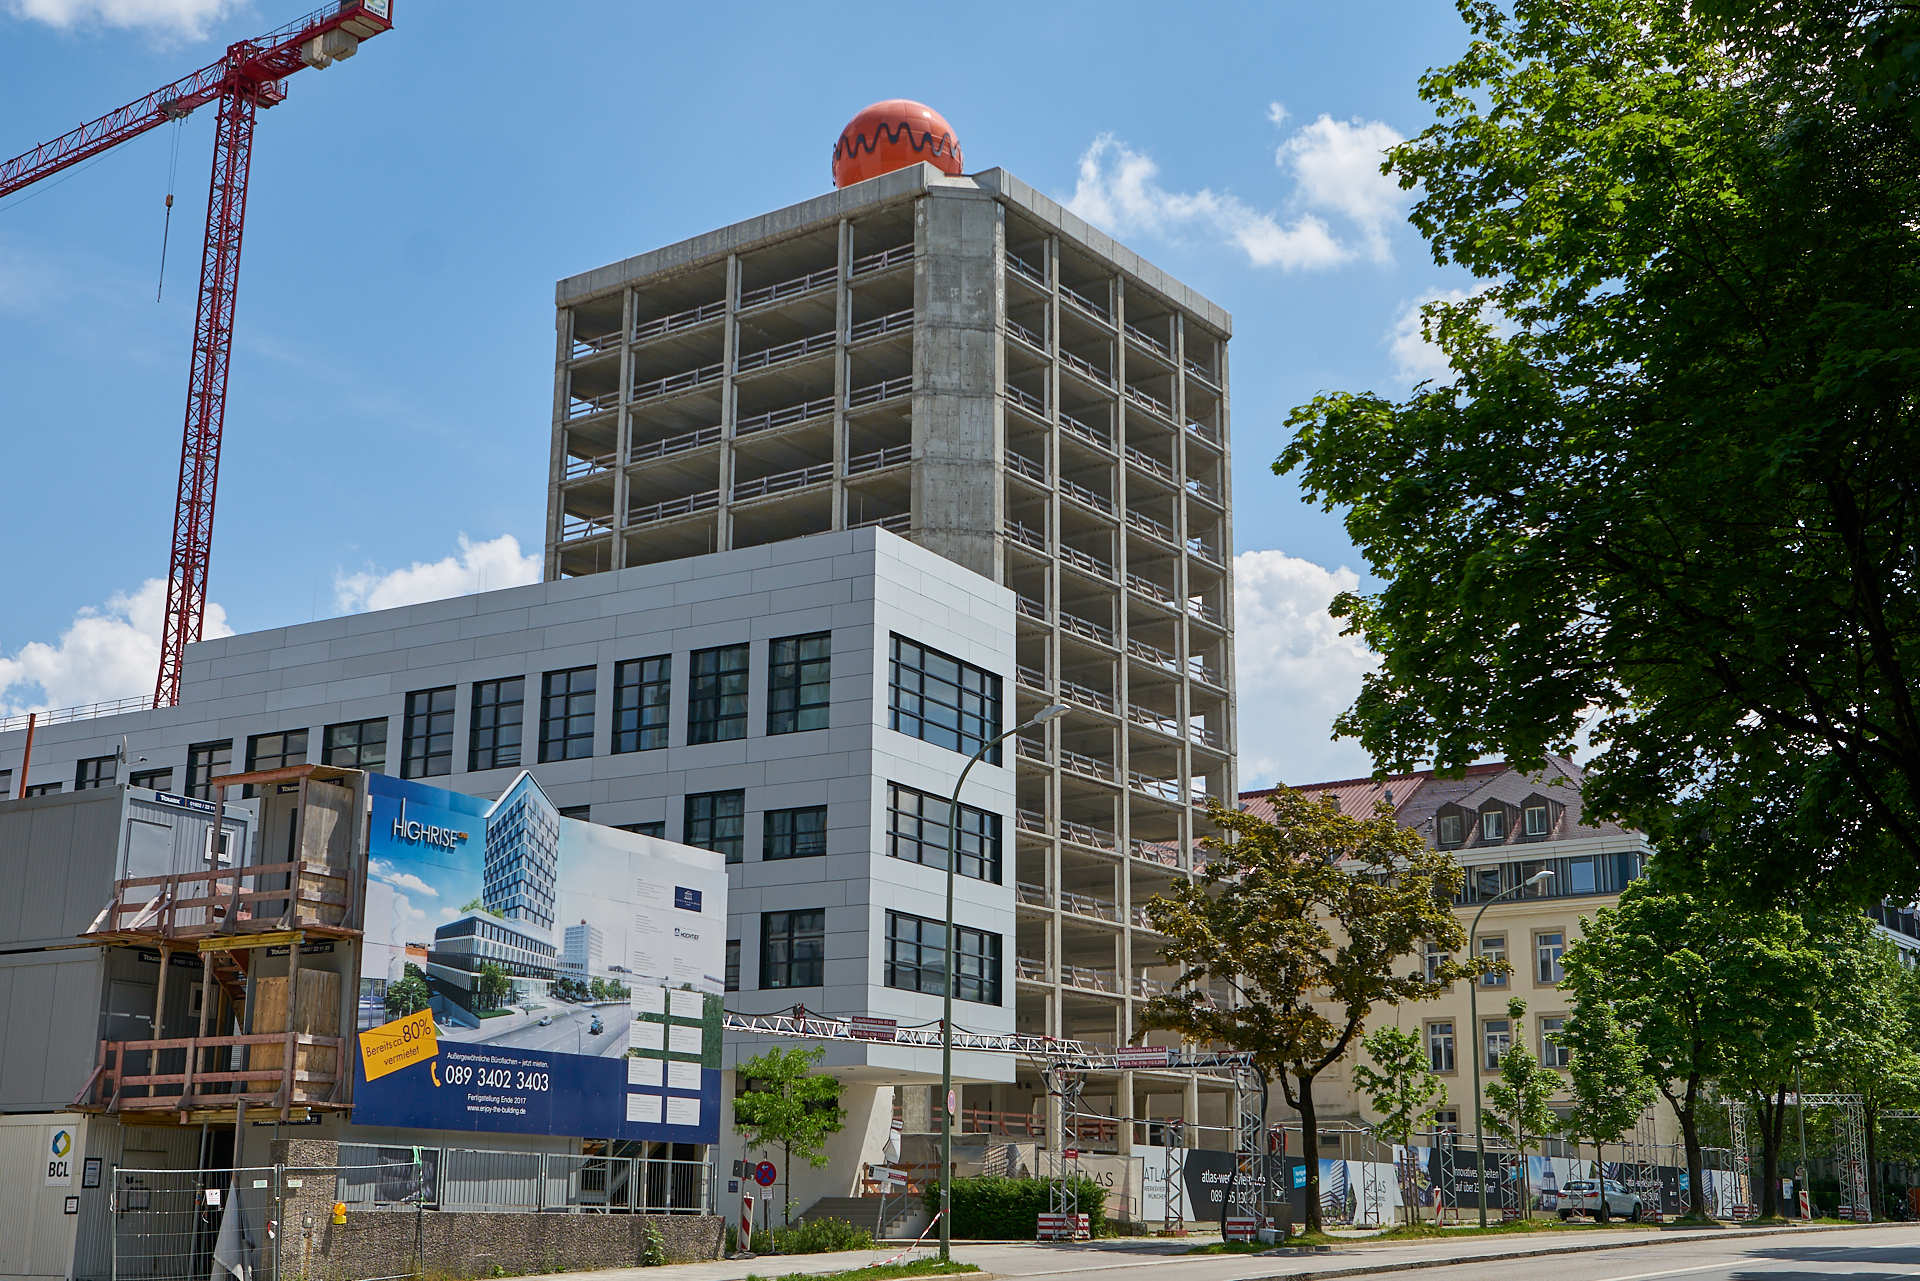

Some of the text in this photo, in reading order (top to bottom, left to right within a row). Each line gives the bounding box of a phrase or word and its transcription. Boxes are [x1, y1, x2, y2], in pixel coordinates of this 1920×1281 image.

[366, 4, 386, 16] WILBERT
[394, 797, 458, 848] HIGHRISE
[681, 932, 699, 940] HOCHTIEF
[366, 1042, 392, 1057] Bereits
[402, 1018, 431, 1042] 80%
[383, 1046, 419, 1065] vermietet
[447, 1052, 490, 1063] Außergewöhnliche
[522, 1059, 531, 1067] jetzt
[445, 1065, 549, 1092] 089 3402 3403
[468, 1094, 500, 1104] Fertigstellung
[501, 1095, 513, 1104] Ende
[467, 1105, 526, 1115] www.enjoy-the-building.de
[48, 1162, 69, 1178] BCL
[1144, 1166, 1166, 1182] ATLA
[1463, 1181, 1474, 1192] über
[1210, 1189, 1222, 1203] 089
